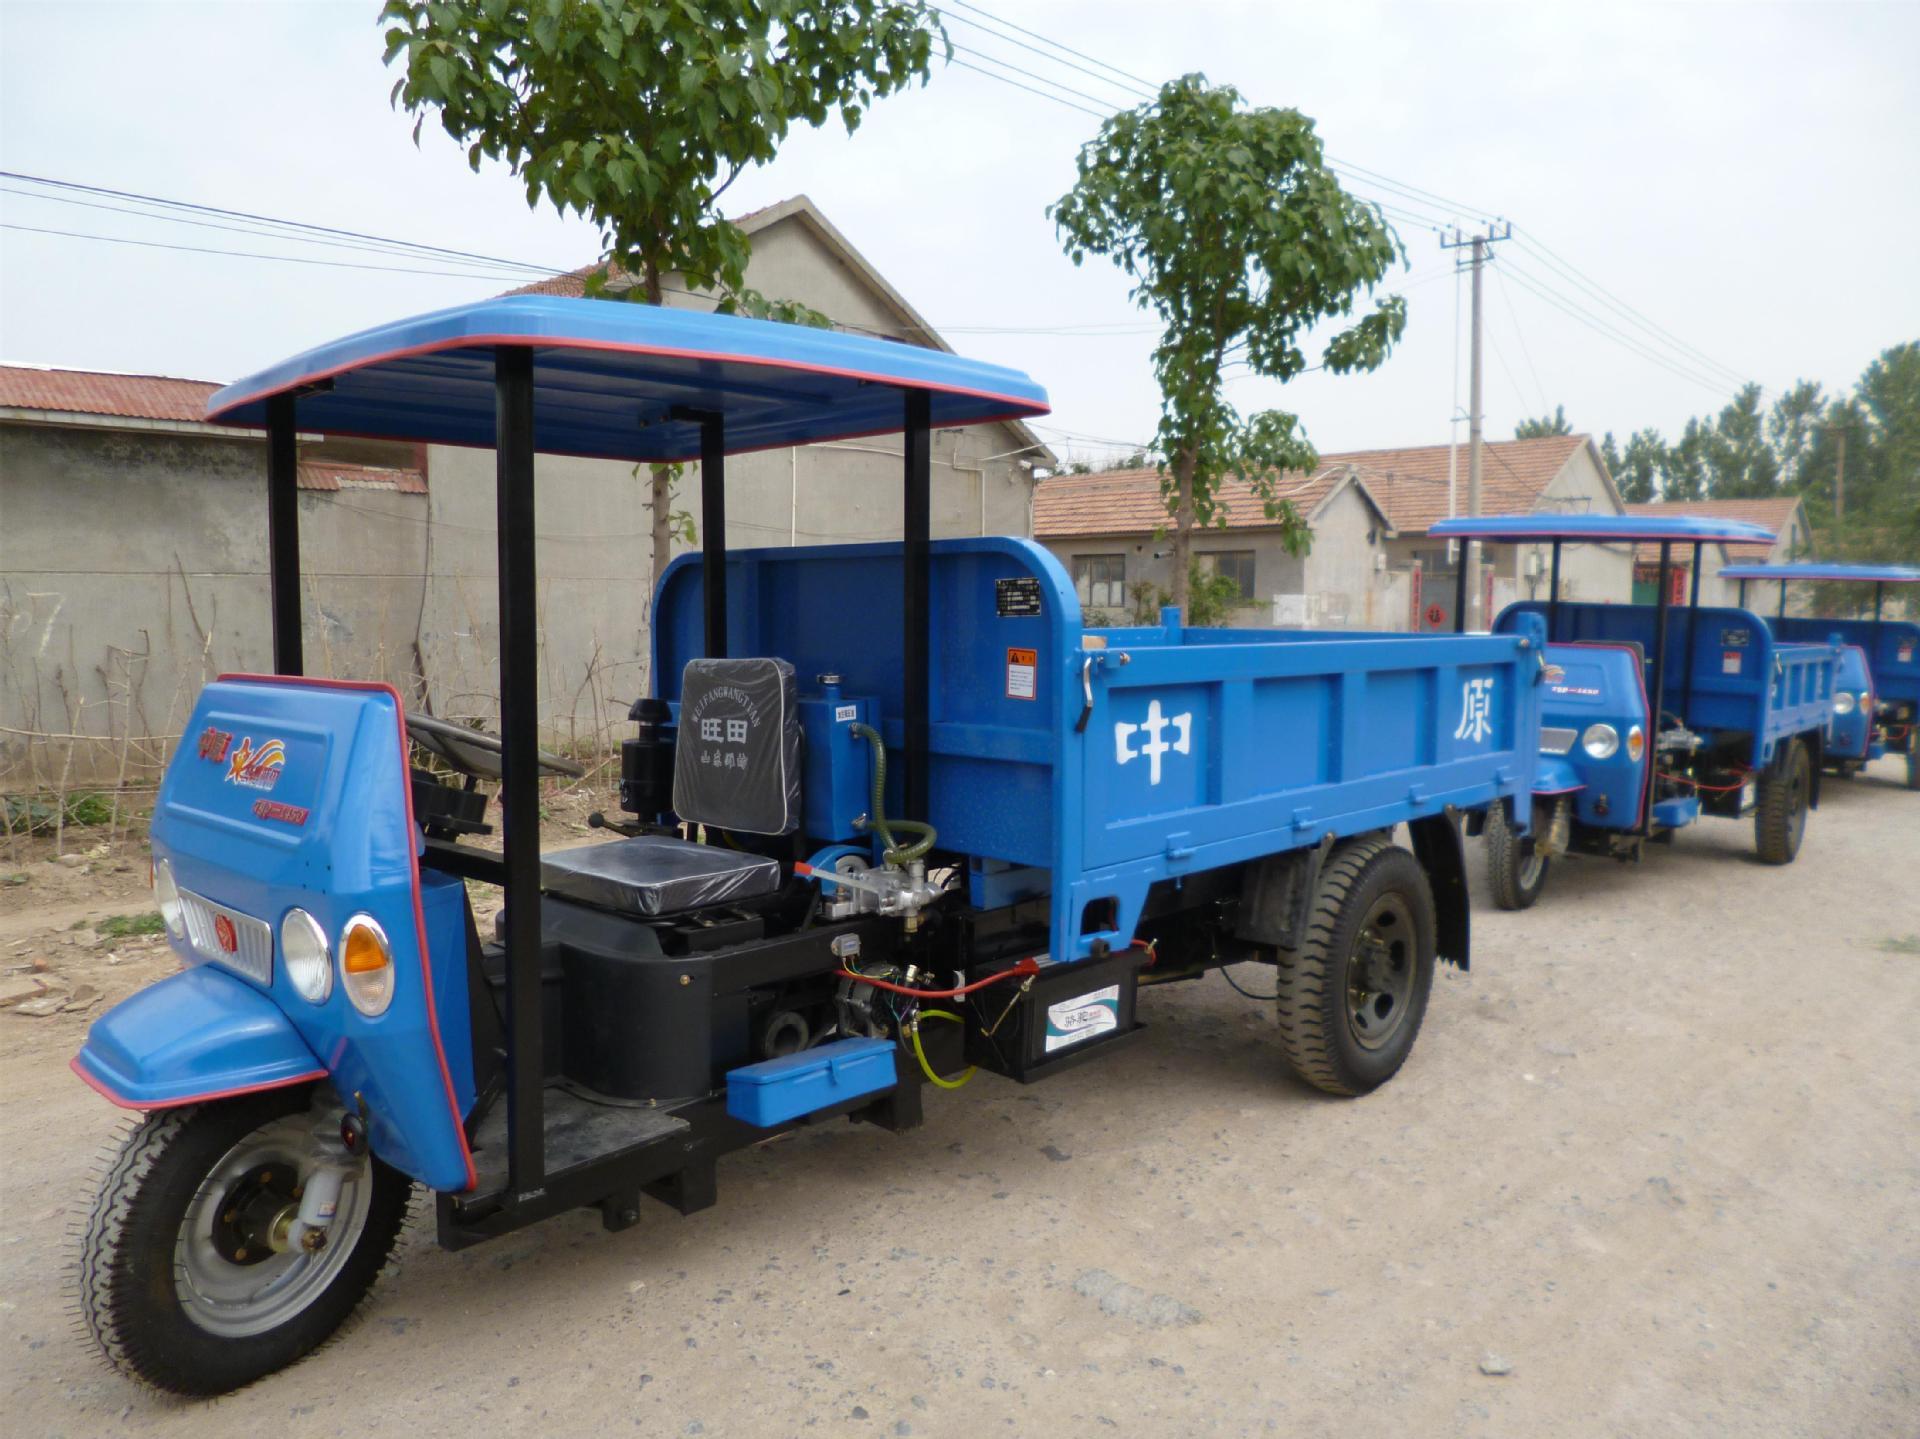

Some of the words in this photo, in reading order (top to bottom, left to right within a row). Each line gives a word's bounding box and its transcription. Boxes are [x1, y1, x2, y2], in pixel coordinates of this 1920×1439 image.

[701, 718, 748, 745] 旺田
[1115, 699, 1192, 786] 中
[1454, 678, 1494, 743] 原
